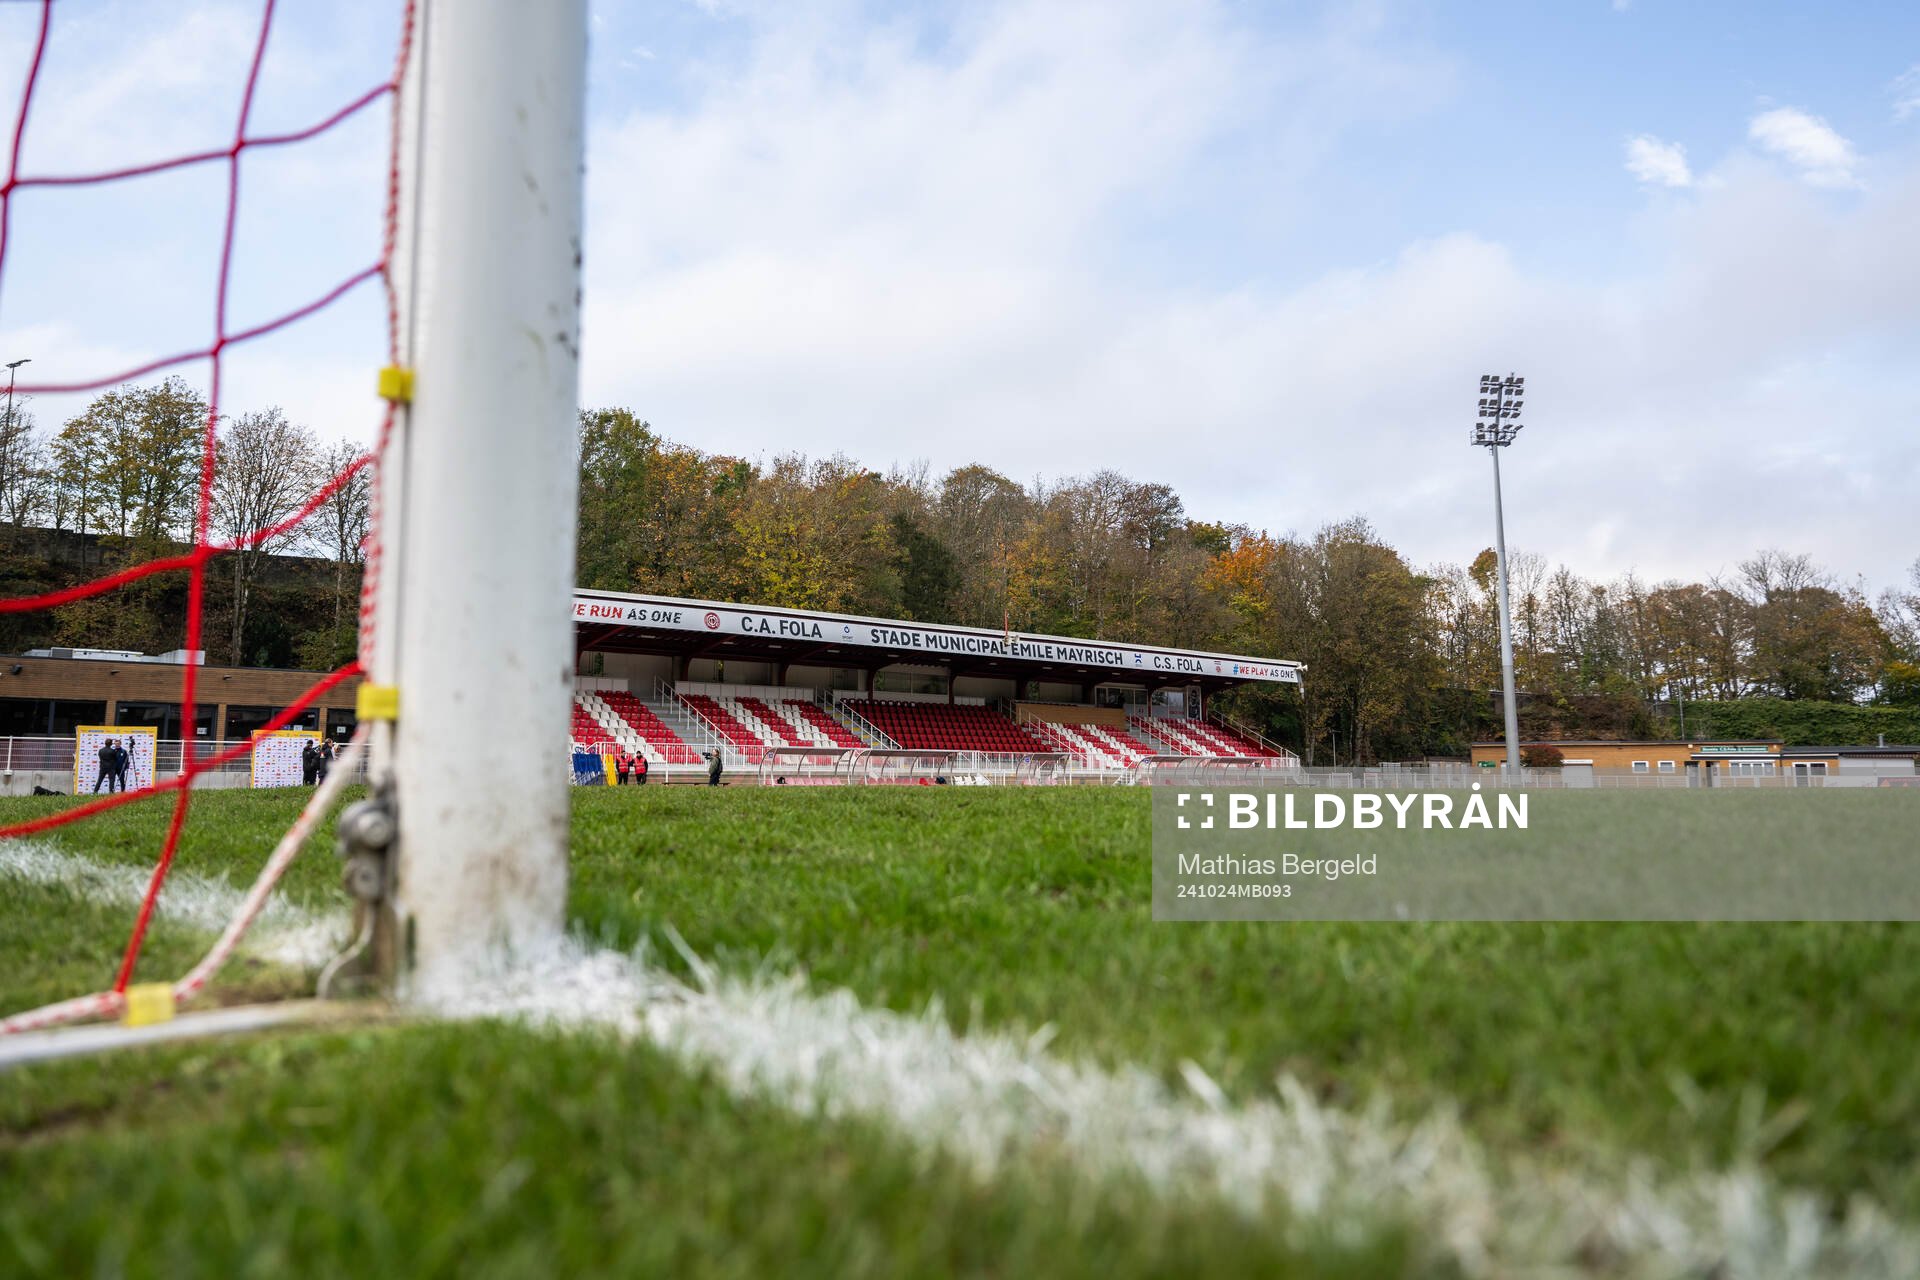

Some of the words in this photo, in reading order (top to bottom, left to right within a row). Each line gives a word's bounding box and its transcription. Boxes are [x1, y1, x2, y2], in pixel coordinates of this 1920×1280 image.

[589, 605, 623, 619] RUN
[627, 608, 648, 621] AS
[650, 610, 683, 624] ONE
[741, 616, 776, 635] C.A.
[779, 619, 822, 639] FOLA
[870, 628, 921, 647] STADE
[925, 634, 1007, 655] MUNICIPAL
[1057, 647, 1123, 665] MAYRISCH
[1153, 656, 1175, 671] C.S.
[1177, 658, 1204, 673] FOLA
[1251, 666, 1269, 677] PLAY
[1270, 669, 1279, 678] AS
[1280, 670, 1295, 679] ONE
